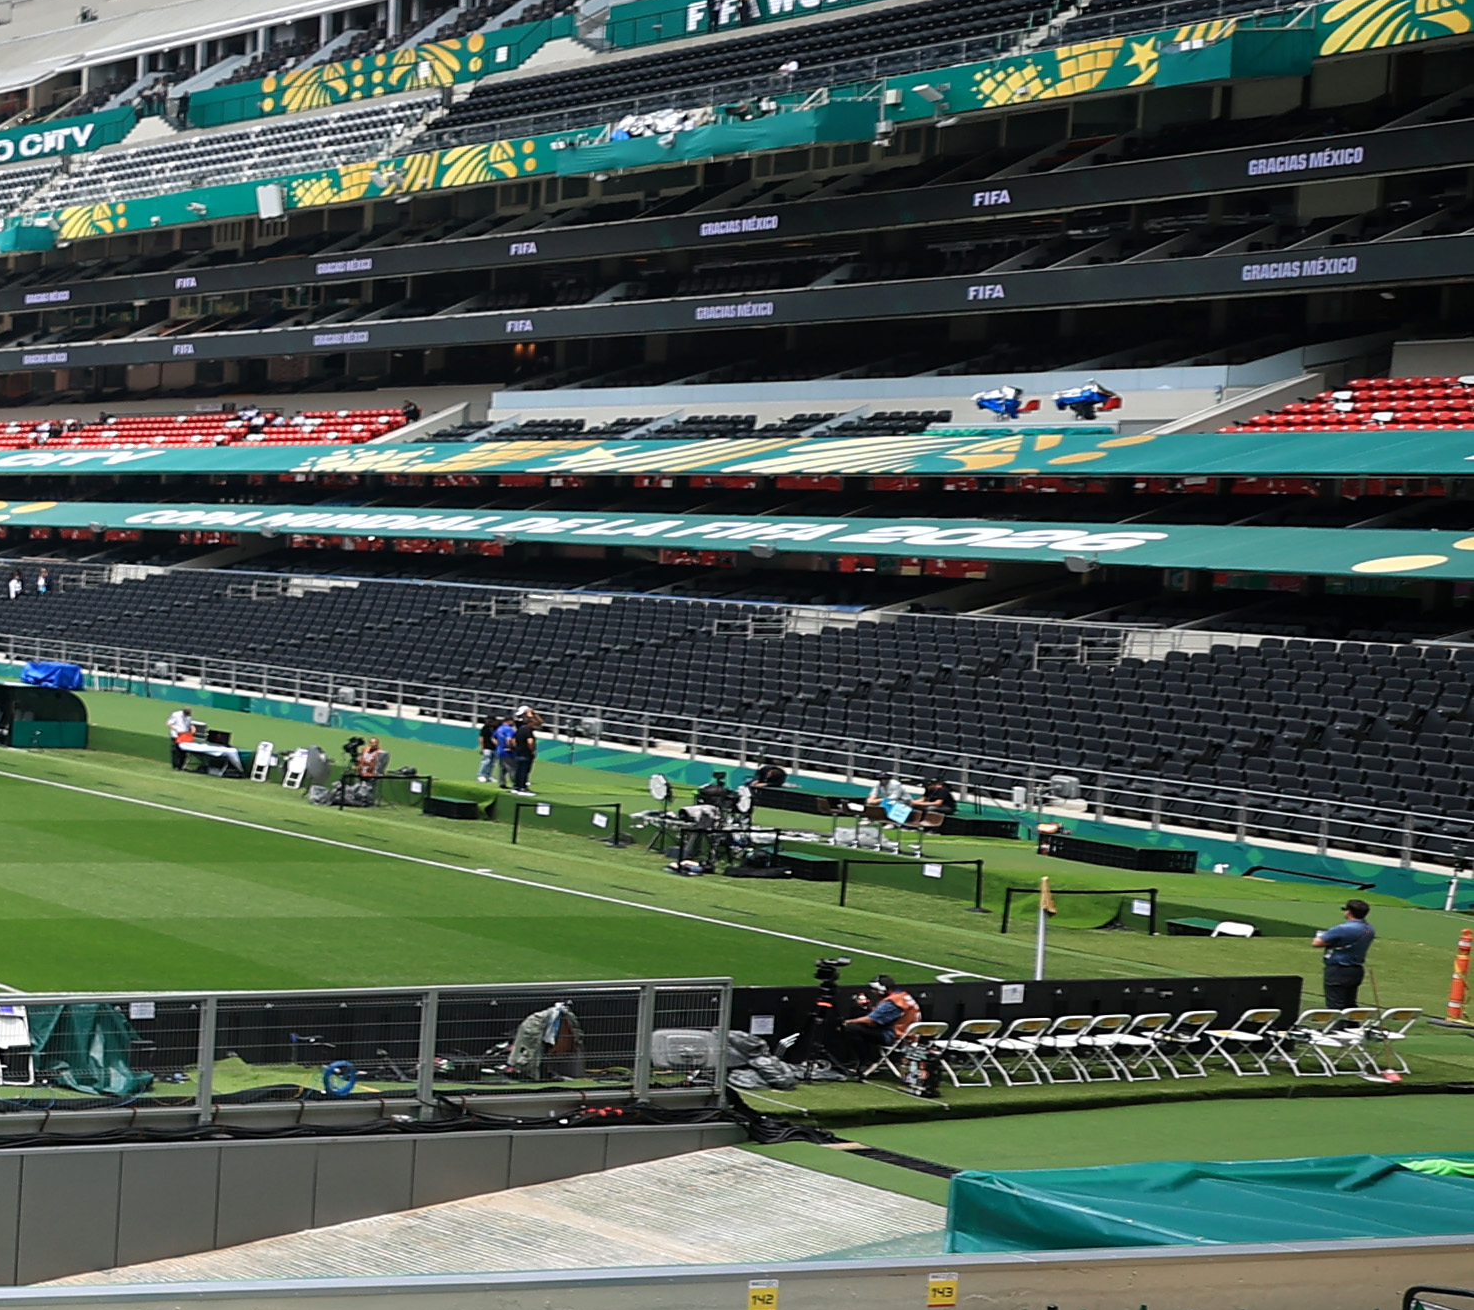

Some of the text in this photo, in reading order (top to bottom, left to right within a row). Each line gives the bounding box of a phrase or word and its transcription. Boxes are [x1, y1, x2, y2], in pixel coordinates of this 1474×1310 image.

[19, 123, 95, 156] CITY
[1247, 146, 1364, 175] GRACIAS MÉXICO
[973, 189, 1011, 207] FIFA
[509, 242, 538, 256] FIFA
[1243, 255, 1357, 282] GRACIAS MÉXICO
[967, 284, 1006, 301] FIFA
[505, 319, 534, 333] FIFA
[126, 509, 1169, 551] COPA MUNDIAL DE LA FIFA 2026
[751, 1294, 774, 1306] 142
[931, 1286, 954, 1298] 143
